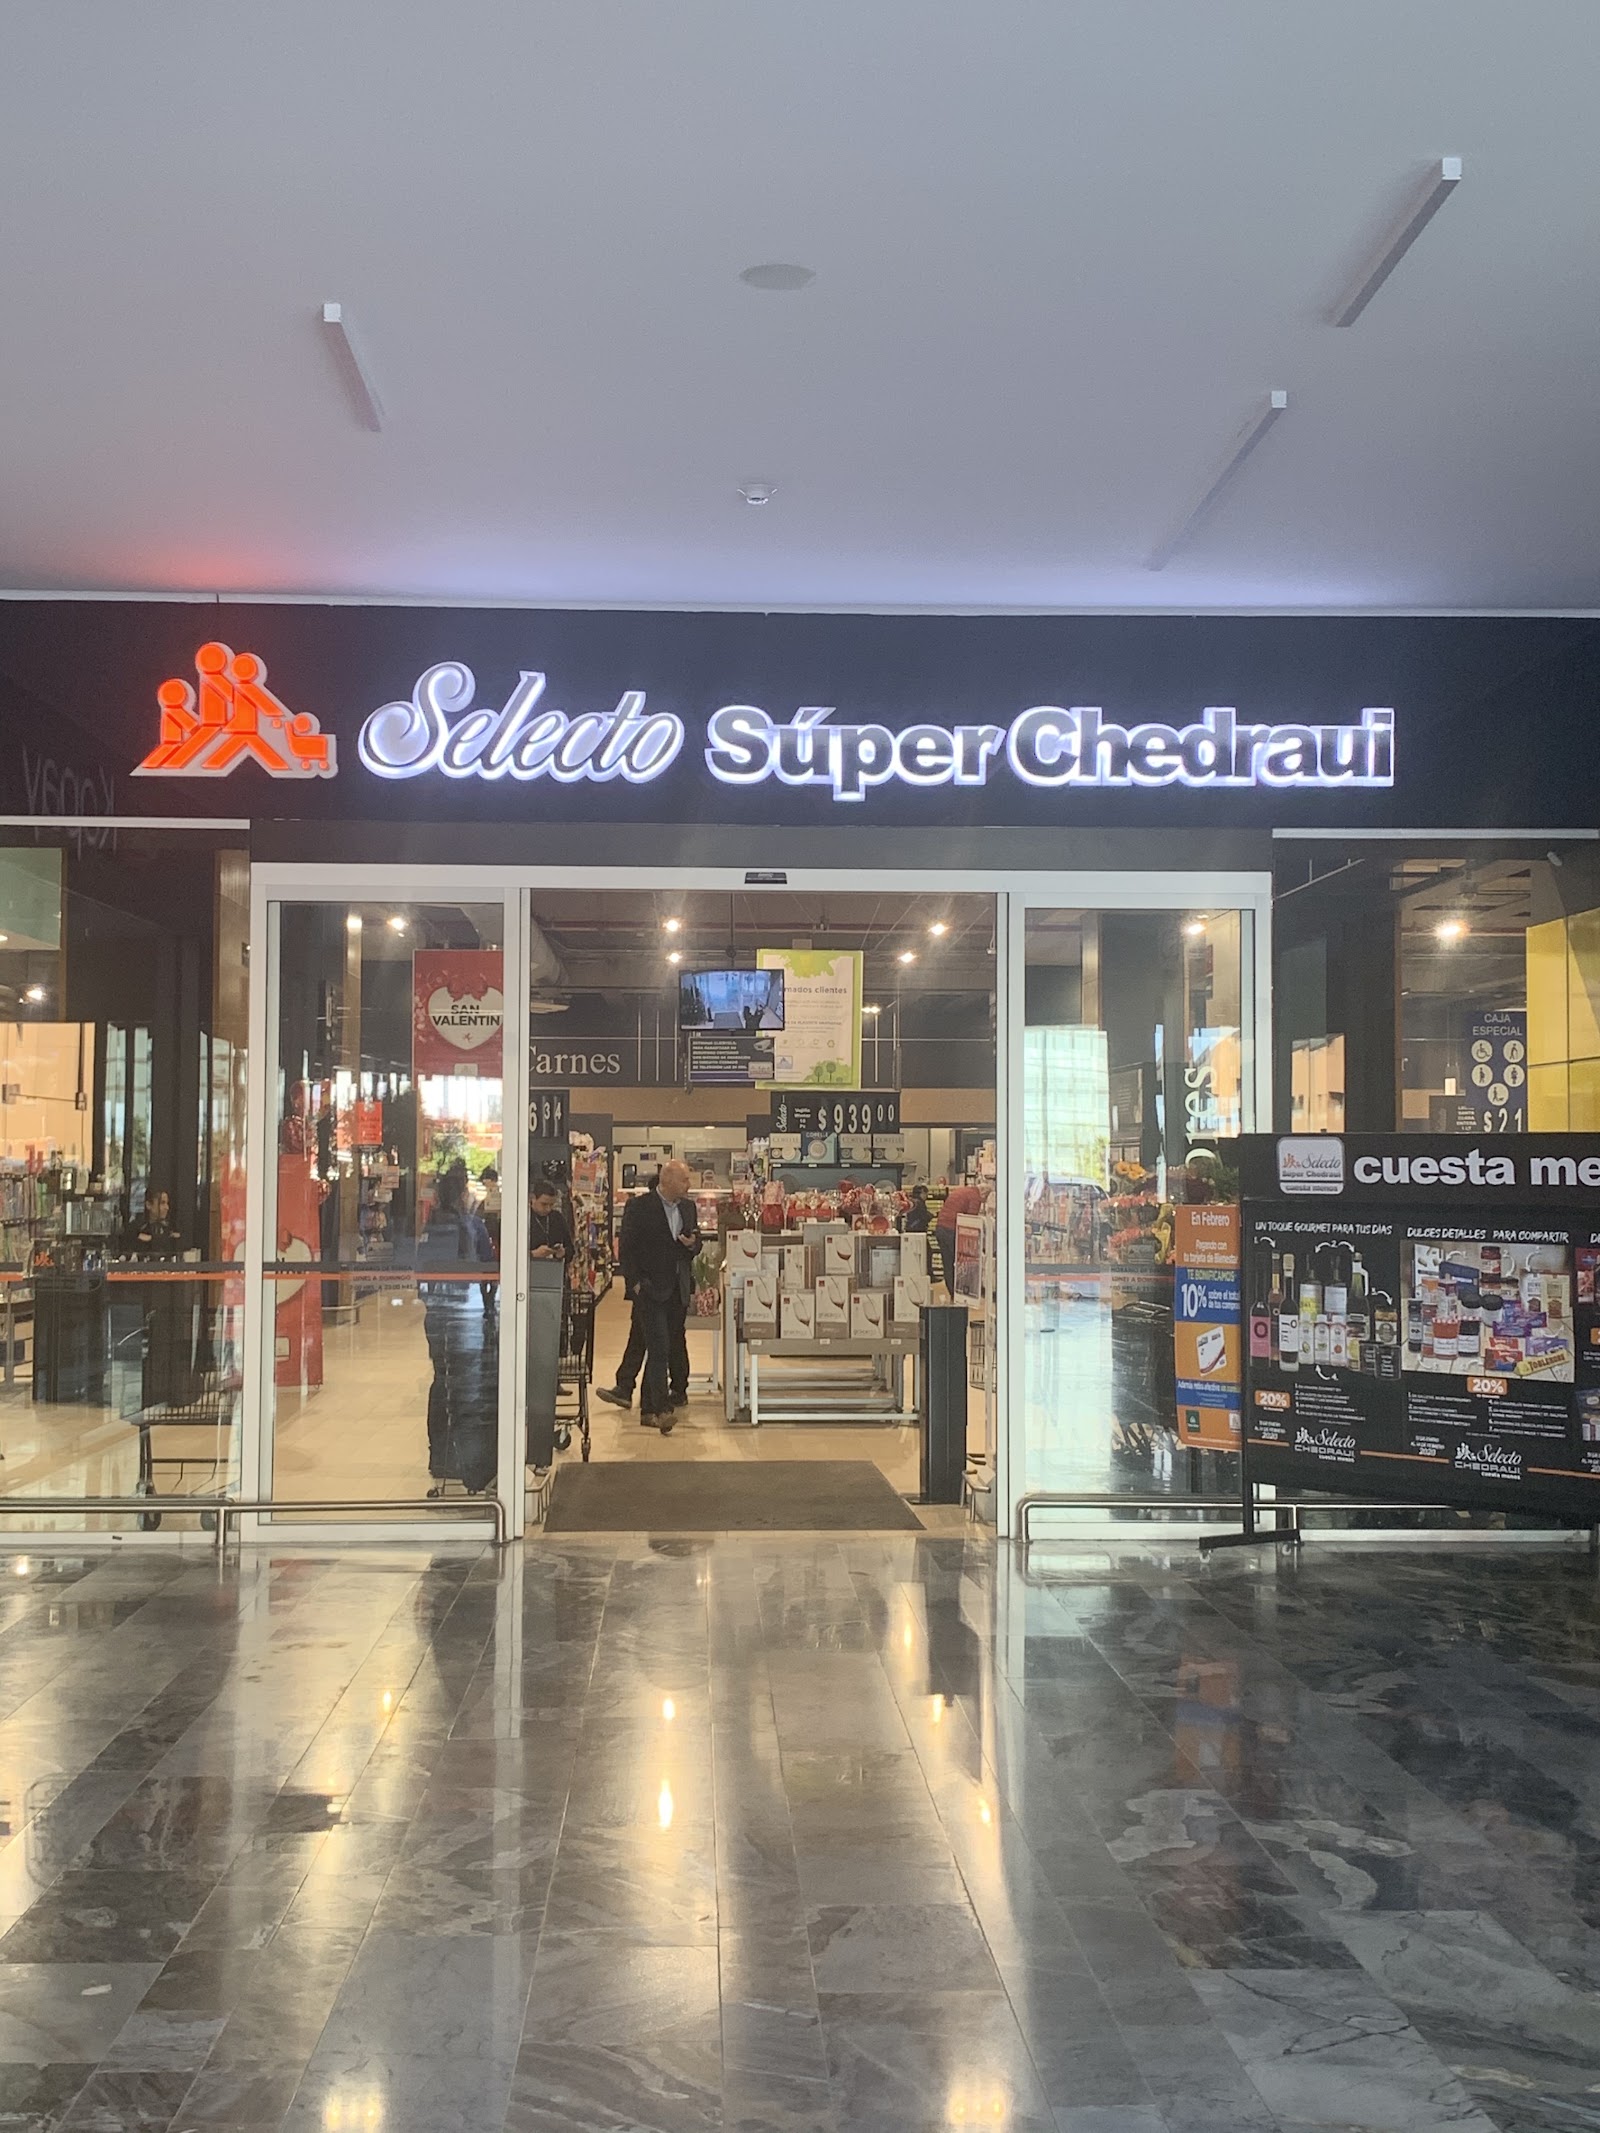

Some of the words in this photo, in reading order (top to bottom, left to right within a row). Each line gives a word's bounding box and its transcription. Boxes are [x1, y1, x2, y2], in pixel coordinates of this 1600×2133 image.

[358, 661, 686, 783] Selecto
[1007, 706, 1395, 786] Chedraui
[814, 986, 847, 994] clientes
[451, 1004, 480, 1014] SAN
[432, 1015, 500, 1026] VALENTIN
[1484, 1014, 1511, 1023] CAJA
[1472, 1026, 1523, 1036] ESPECIAL
[1301, 1153, 1341, 1169] Selecto
[1354, 1148, 1516, 1186] cuesta
[1191, 1211, 1200, 1226] En
[1202, 1212, 1230, 1227] Febrero
[1255, 1222, 1267, 1230] UN
[1268, 1221, 1292, 1231] TOQUE
[1294, 1222, 1331, 1233] GOURMET
[1332, 1224, 1354, 1234] PARA
[1356, 1224, 1371, 1234] TUS
[1407, 1227, 1441, 1238] DULCES
[1442, 1228, 1486, 1240] DETALLES
[1493, 1230, 1517, 1242] PARA
[1518, 1230, 1569, 1243] COMPARTIR
[1181, 1283, 1207, 1318] 10%
[1472, 1378, 1505, 1393] 20%
[1260, 1392, 1287, 1406] 20%
[1315, 1428, 1356, 1448] Selecto
[1295, 1445, 1355, 1457] CHEDRAUI
[1477, 1443, 1522, 1465] Selecto
[1455, 1461, 1522, 1474] CHEDRAUI
